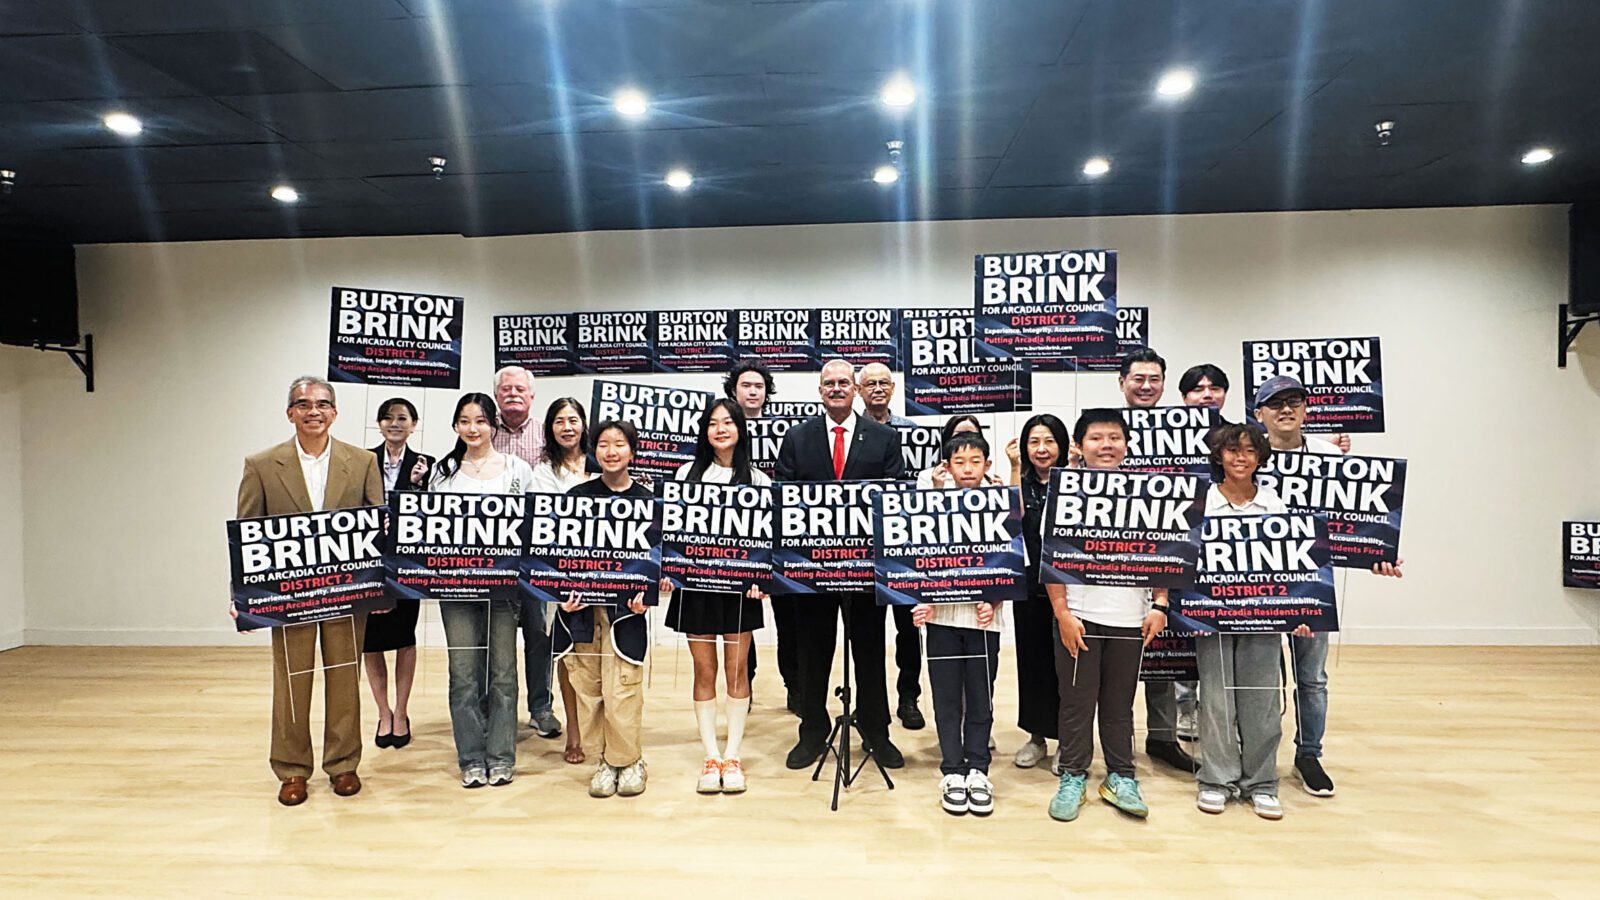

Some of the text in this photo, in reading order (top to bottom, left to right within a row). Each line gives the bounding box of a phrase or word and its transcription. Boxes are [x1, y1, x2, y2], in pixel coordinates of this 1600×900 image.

[984, 252, 1105, 276] BURTON
[984, 274, 1105, 304] BRINK
[341, 290, 454, 316] BURTON
[1002, 306, 1042, 314] ARCADIA
[1066, 304, 1107, 312] COUNCIL
[499, 316, 566, 329] BURTON
[579, 313, 646, 325] BURTON
[659, 311, 727, 324] BURTON
[740, 311, 808, 322] BURTON
[821, 310, 891, 322] BURTON
[1012, 315, 1076, 325] DISTRICT 2
[339, 310, 453, 341] BRINK
[739, 323, 808, 340] BRINK
[821, 323, 891, 339] BRINK
[499, 329, 567, 346] BRINK
[579, 325, 647, 342] BRINK
[659, 324, 728, 341] BRINK
[356, 338, 394, 346] ARCADIA
[417, 342, 454, 350] COUNCIL
[1252, 340, 1370, 361] BURTON
[366, 348, 416, 358] DISTRICT
[940, 375, 987, 385] DISTRICT
[602, 383, 706, 410] BURTON
[1059, 472, 1197, 498] BURTON
[400, 494, 525, 517] BURTON
[534, 495, 654, 520] BURTON
[882, 489, 1010, 514] BURTON
[1055, 496, 1194, 530] BRINK
[1344, 513, 1391, 524] COUNCIL
[240, 509, 379, 543] BURTON
[662, 503, 772, 538] BRINK
[782, 507, 874, 536] BRIN
[398, 516, 523, 546] BRINK
[532, 517, 652, 549] BRINK
[883, 512, 1012, 546] BRINK
[1053, 528, 1191, 541] FOR ARCADIA CITY COUNCIL
[1201, 516, 1316, 540] URTON
[1347, 524, 1354, 533] 2
[678, 534, 737, 546] ARCADIA CITY
[802, 538, 843, 546] ARCADIA
[1085, 540, 1156, 553] DISTRICT 2
[242, 530, 382, 573] BRINK
[417, 546, 460, 554] ARCADIA
[530, 547, 548, 555] FOR
[550, 548, 589, 557] ARCADIA
[613, 551, 653, 560] COUNCIL
[686, 546, 747, 559] DISTRICT 2
[812, 549, 867, 559] DISTRICT
[884, 543, 1015, 556] FOR ARCADIA CITY COUNCIL
[1197, 540, 1319, 572] RINK
[428, 557, 493, 567] DISTRICT 2
[559, 559, 622, 571] DISTRICT 2
[916, 556, 984, 568] DISTRICT 2
[1052, 562, 1084, 571] Putting
[244, 559, 384, 584] FOR ARCADIA CITY COUNCIL
[1199, 572, 1323, 583] ARCADIA CITY COUNCIL
[280, 574, 352, 591] DISTRICT 2
[529, 579, 558, 588] Putting
[887, 581, 918, 589] Putting
[1212, 585, 1287, 596] DISTRICT 2
[249, 605, 284, 615] Putting
[286, 600, 320, 609] Arcadia
[322, 594, 363, 604] Residents
[1182, 609, 1215, 618] Putting
